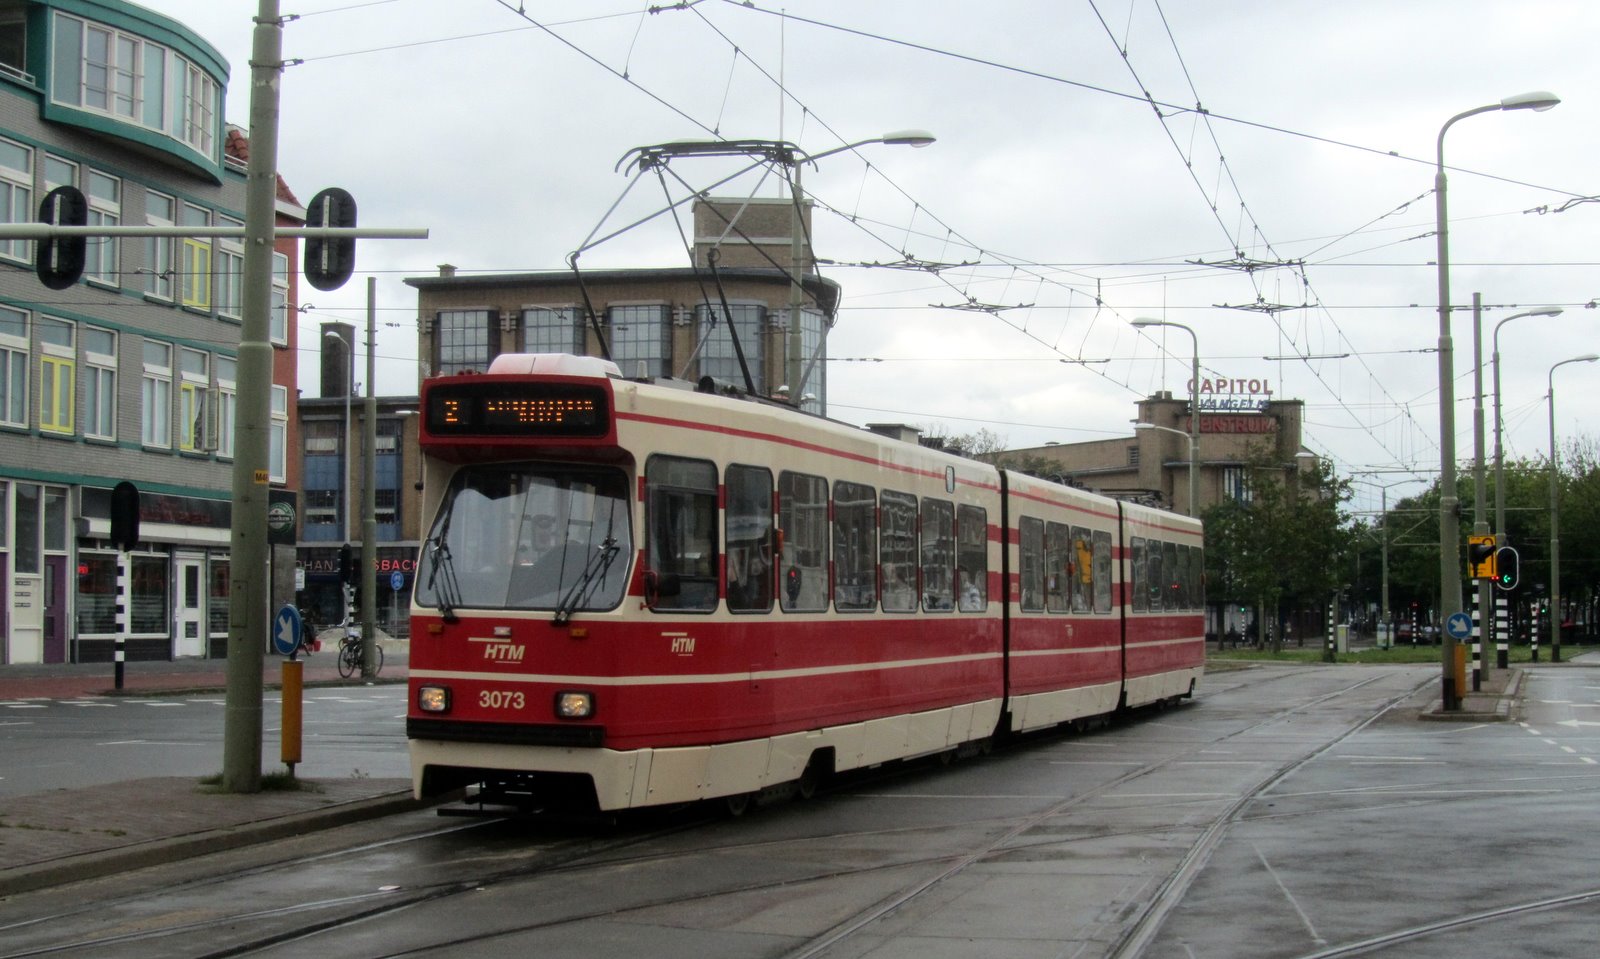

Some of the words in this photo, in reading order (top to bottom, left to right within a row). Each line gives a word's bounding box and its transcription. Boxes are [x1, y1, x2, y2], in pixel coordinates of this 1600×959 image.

[1187, 379, 1273, 395] CAPITOL
[445, 401, 458, 422] 2
[484, 643, 526, 661] HTM
[671, 637, 696, 653] HTM
[479, 690, 526, 710] 3073
